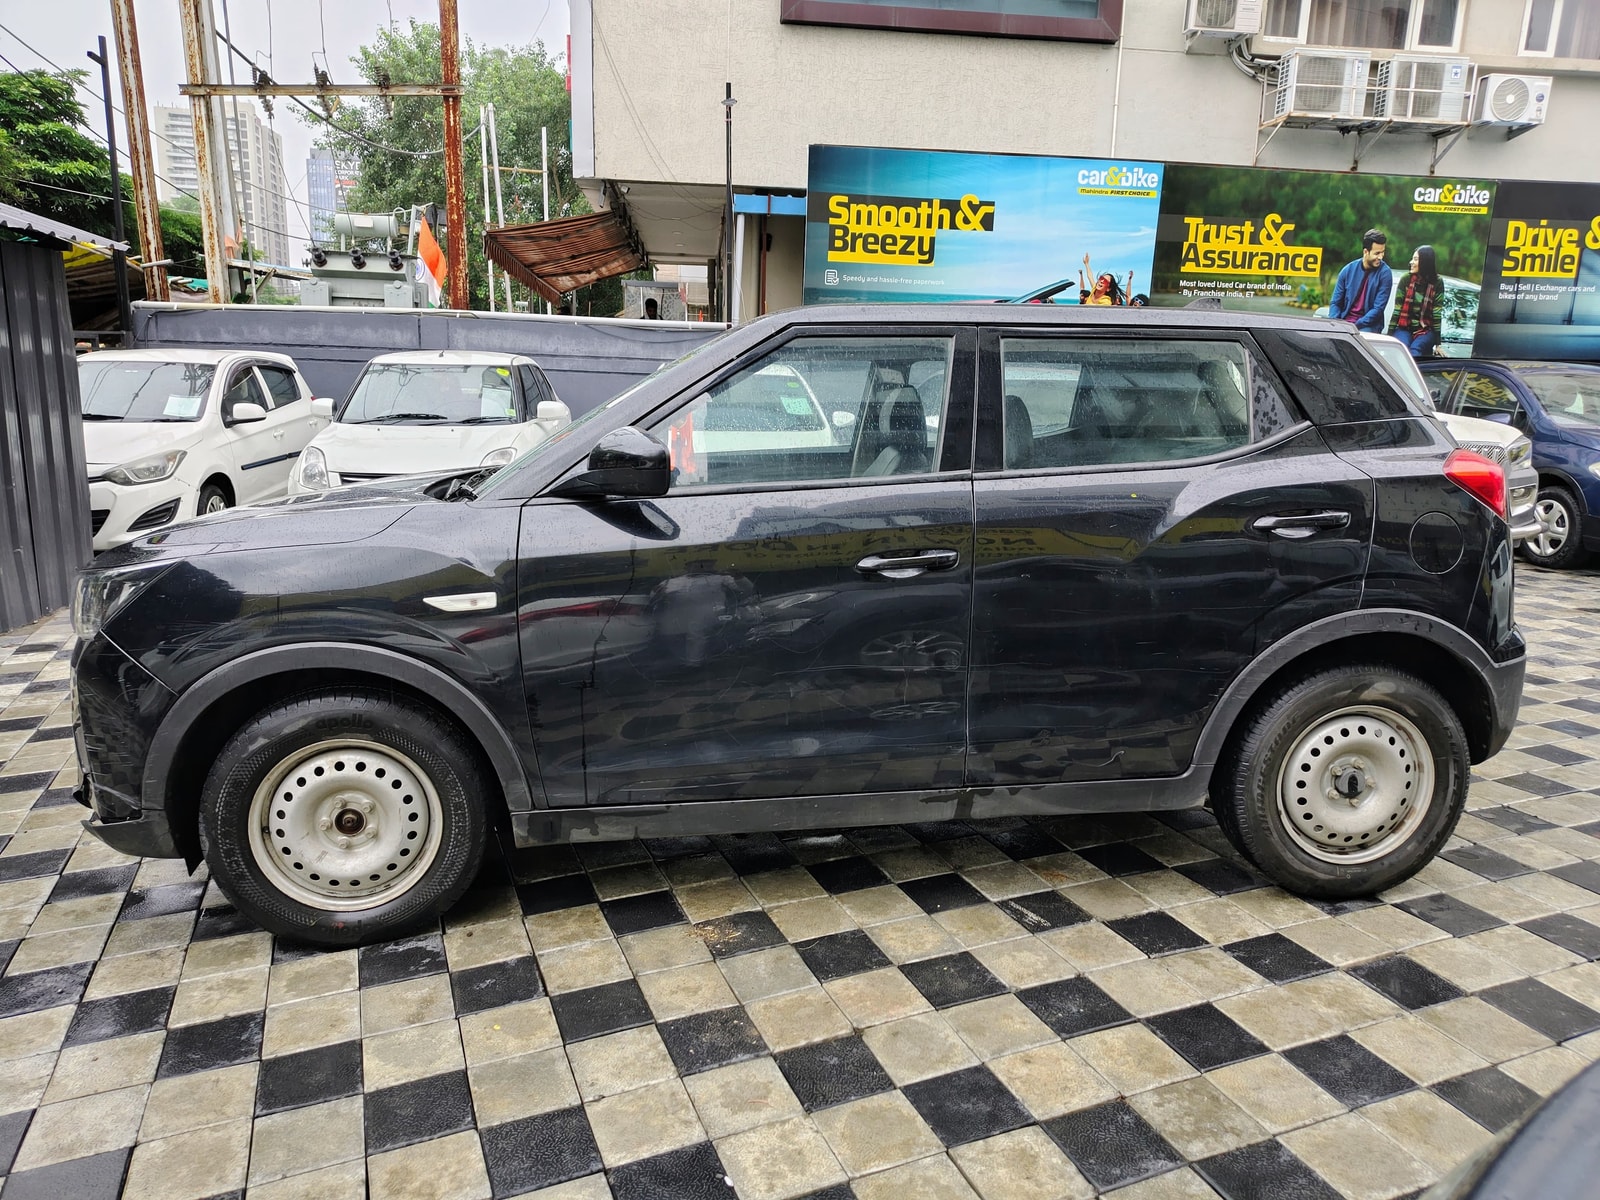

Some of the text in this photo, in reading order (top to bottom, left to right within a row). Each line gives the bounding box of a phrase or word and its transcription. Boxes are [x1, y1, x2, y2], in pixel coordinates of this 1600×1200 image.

[1078, 166, 1159, 188] car&bike
[1414, 183, 1490, 205] car&bike
[828, 193, 996, 231] Smooth &
[1183, 212, 1296, 246] Trust &
[1505, 219, 1579, 249] Drive
[828, 224, 936, 265] Breezy
[1180, 242, 1319, 273] Assurance
[1502, 246, 1576, 274] Smile
[842, 274, 945, 287] Speedy and hassle-free paperwork
[1179, 280, 1292, 291] Most loved Used Car brand of India
[1499, 283, 1514, 292] Buy
[1518, 283, 1531, 291] Sell
[1535, 284, 1567, 293] Exchange
[1582, 285, 1596, 293] and
[1182, 289, 1193, 298] By
[1193, 289, 1226, 298] Franchise
[1226, 290, 1245, 299] India,
[1498, 292, 1516, 300] bikes
[1524, 294, 1538, 302] any
[1538, 293, 1559, 301] brand
[315, 712, 375, 732] apollo
